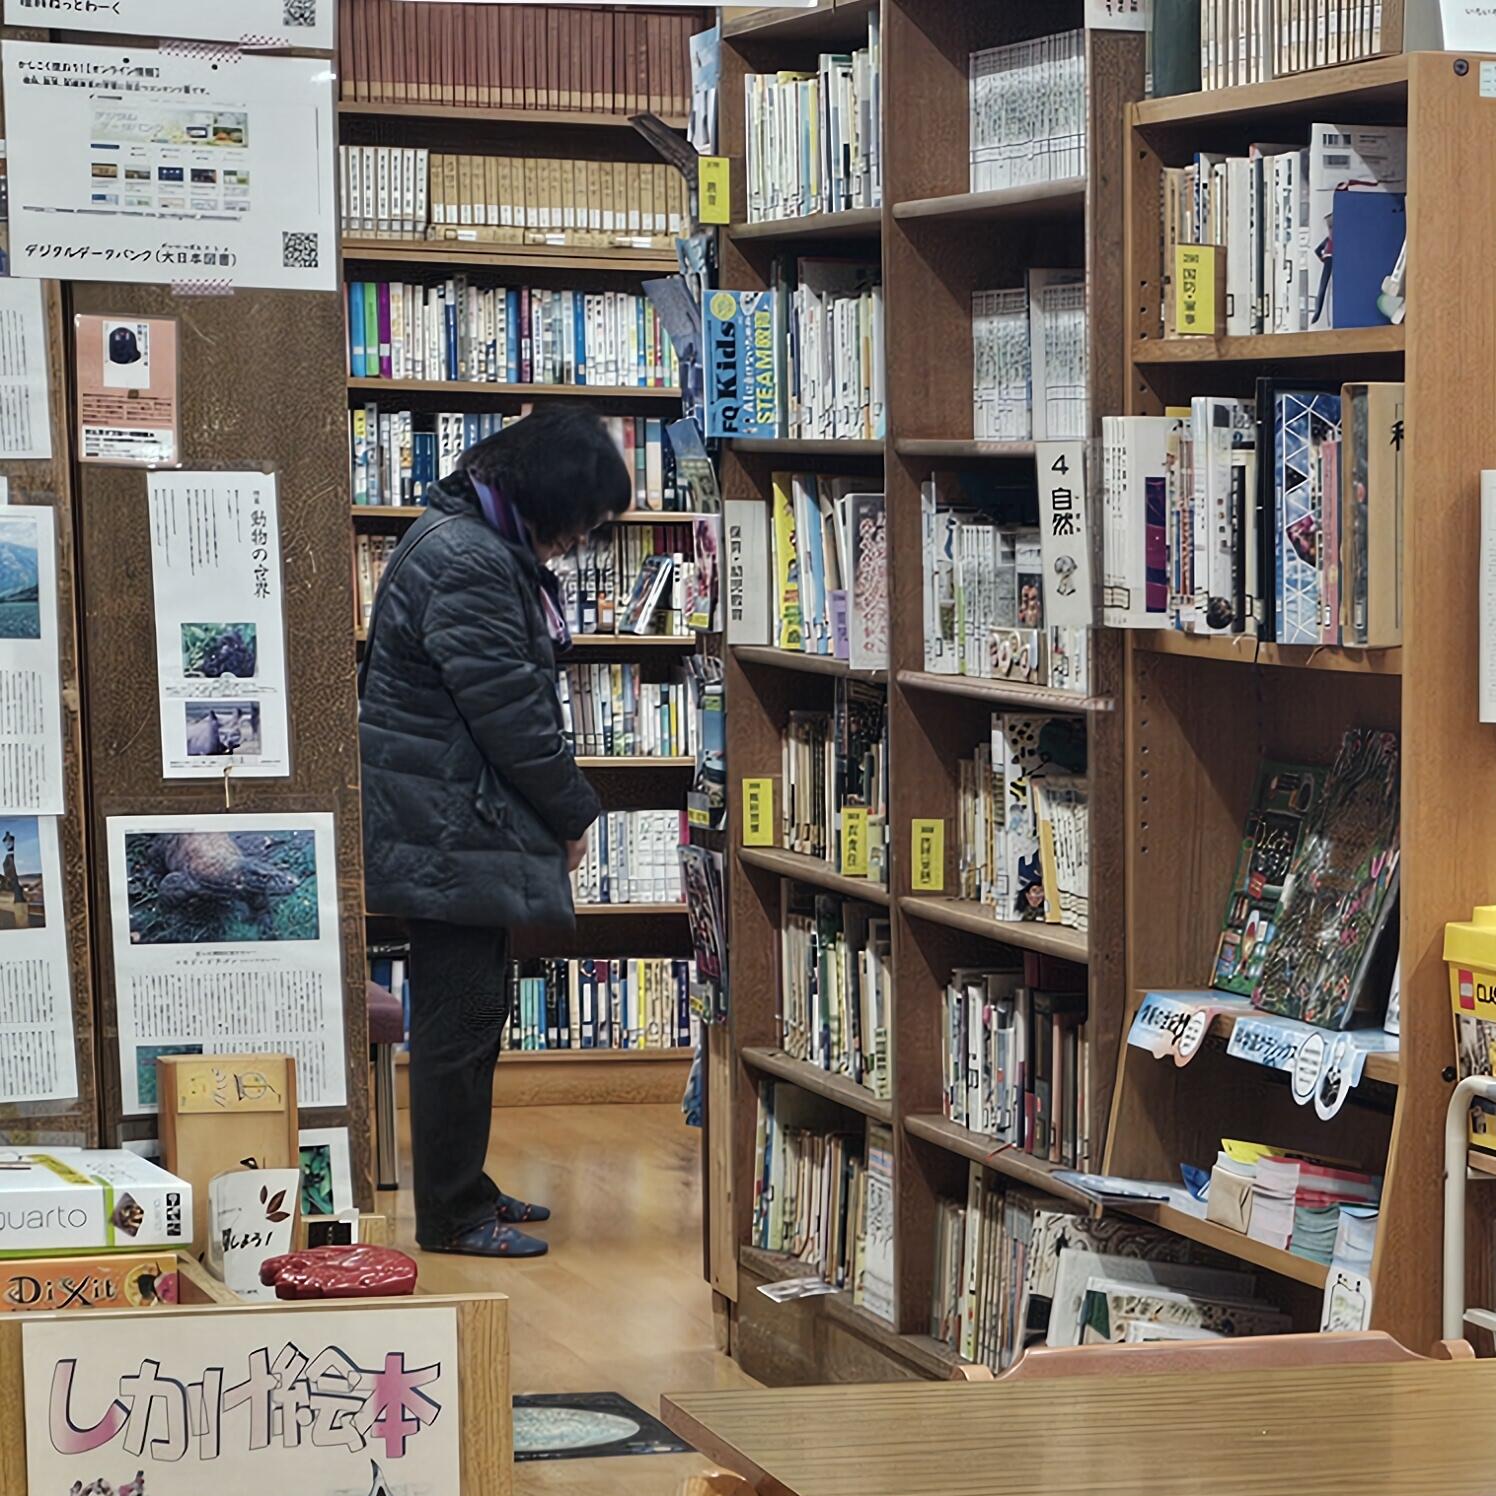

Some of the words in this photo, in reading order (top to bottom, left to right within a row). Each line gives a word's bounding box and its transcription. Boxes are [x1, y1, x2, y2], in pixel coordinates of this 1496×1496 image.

[716, 321, 737, 399] Kids
[1051, 454, 1069, 475] 4
[1051, 487, 1074, 537] 自然
[49, 1341, 442, 1462] しかけ絵本
